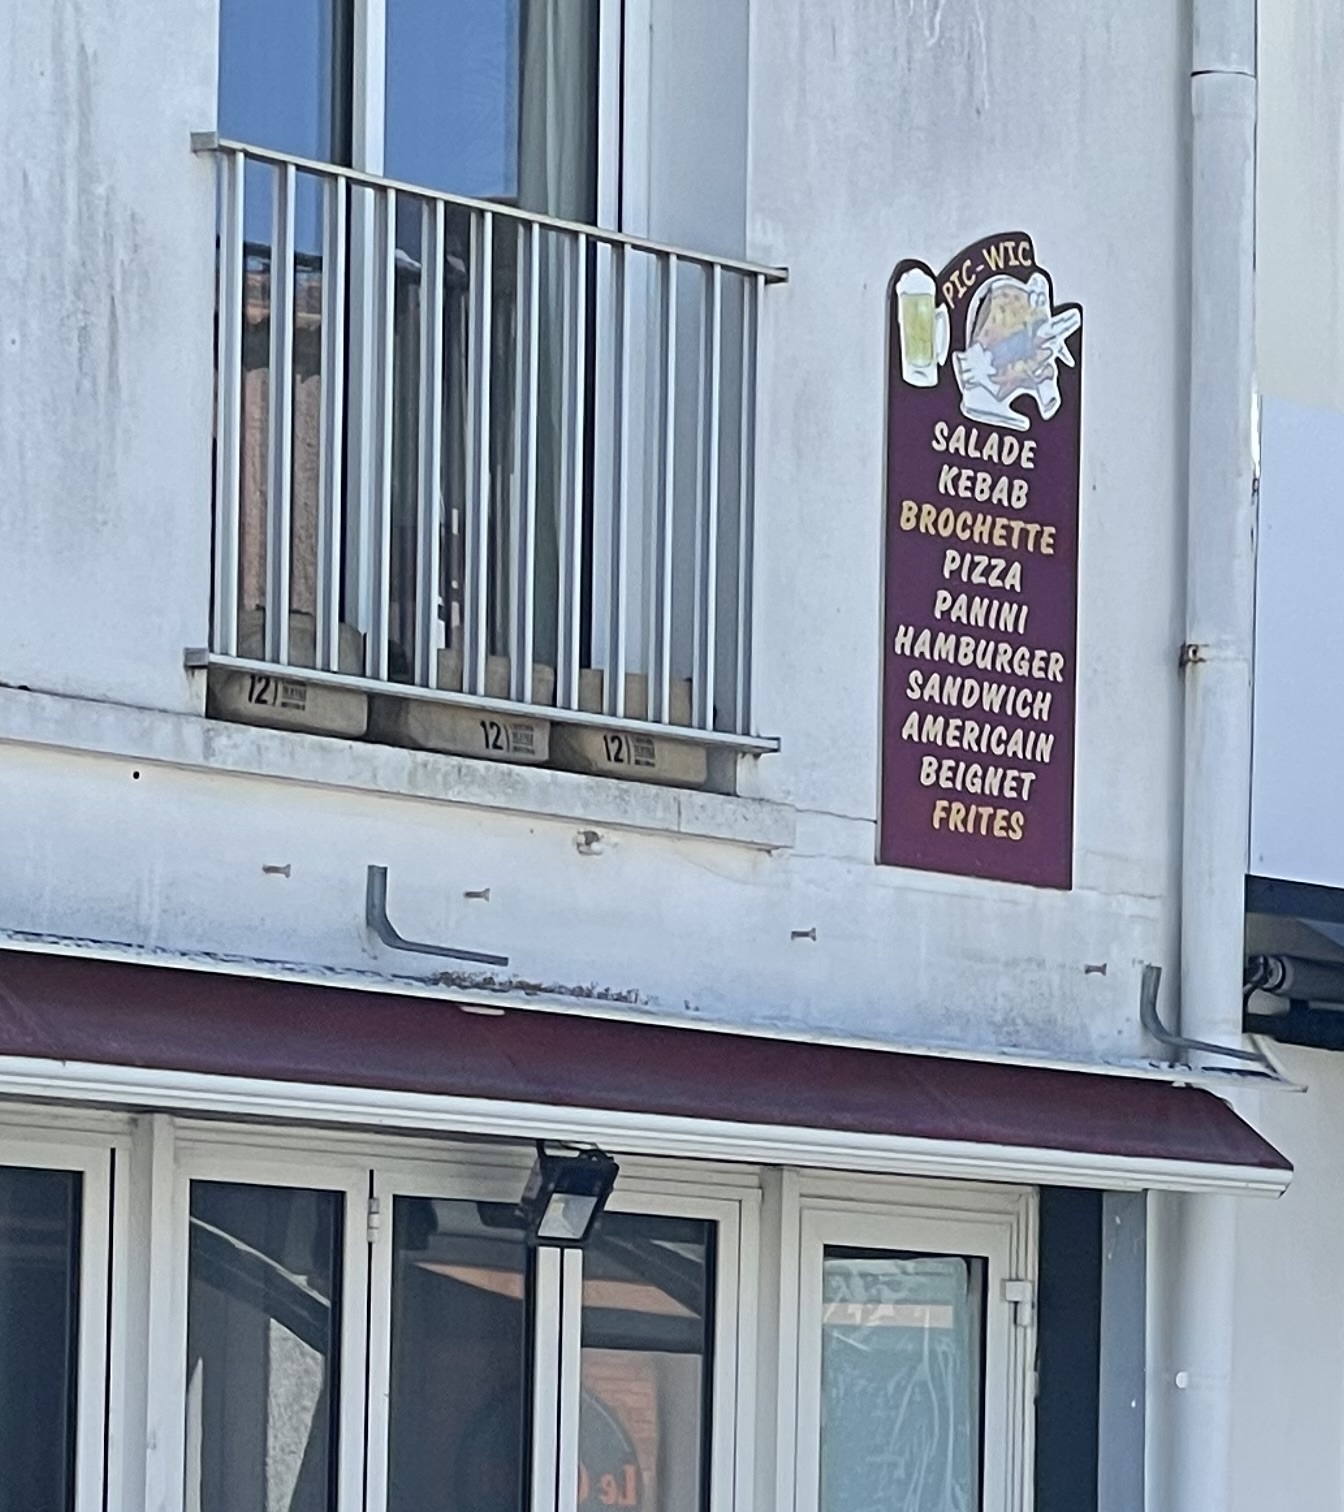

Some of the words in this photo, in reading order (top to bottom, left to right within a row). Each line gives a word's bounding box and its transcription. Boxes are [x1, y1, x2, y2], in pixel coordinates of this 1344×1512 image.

[942, 241, 1032, 309] PIC-WIC
[931, 421, 1037, 469] SALADE
[938, 464, 1029, 509] KEBAB
[900, 500, 1057, 555] BROCHETTE
[942, 549, 1022, 593] PIZZA
[934, 589, 1029, 635] PANINI
[894, 624, 1064, 683] HAMBURGER
[248, 674, 271, 706] 12
[906, 669, 1052, 722] SANDWICH
[479, 719, 504, 751] 12
[603, 734, 624, 763] 12
[901, 711, 1055, 763] AMERICAIN
[920, 755, 1036, 801] BEIGNET
[932, 799, 1025, 840] FRITES
